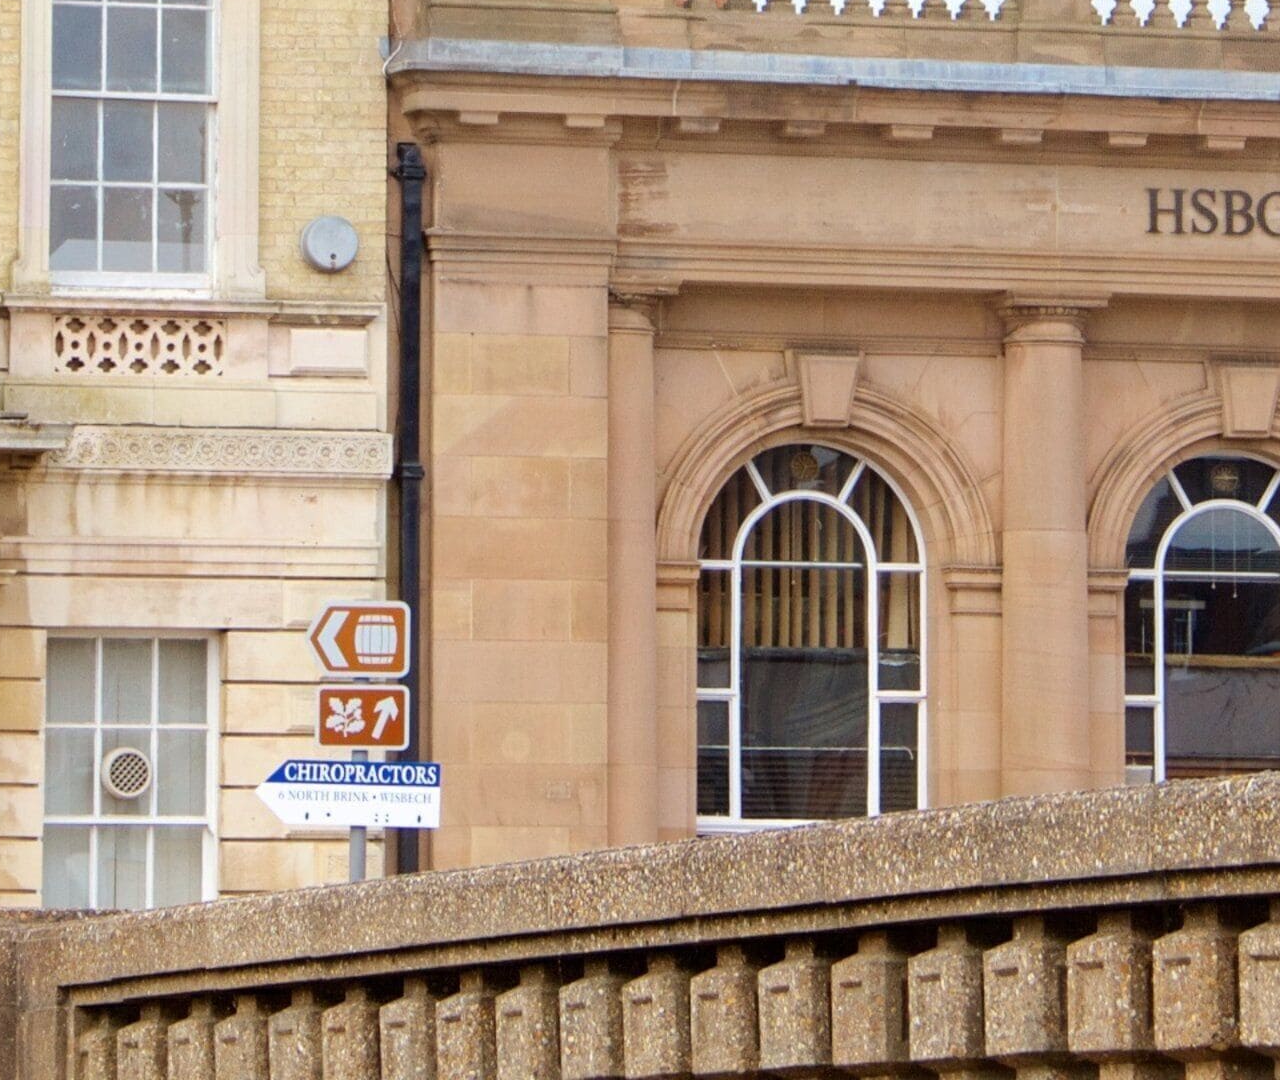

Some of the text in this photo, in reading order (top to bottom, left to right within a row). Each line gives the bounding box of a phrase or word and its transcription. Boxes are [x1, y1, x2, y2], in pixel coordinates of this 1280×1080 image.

[284, 762, 437, 785] CHIROPRACTORS
[278, 789, 432, 804] 6 NORTH BRINK WISBECH
